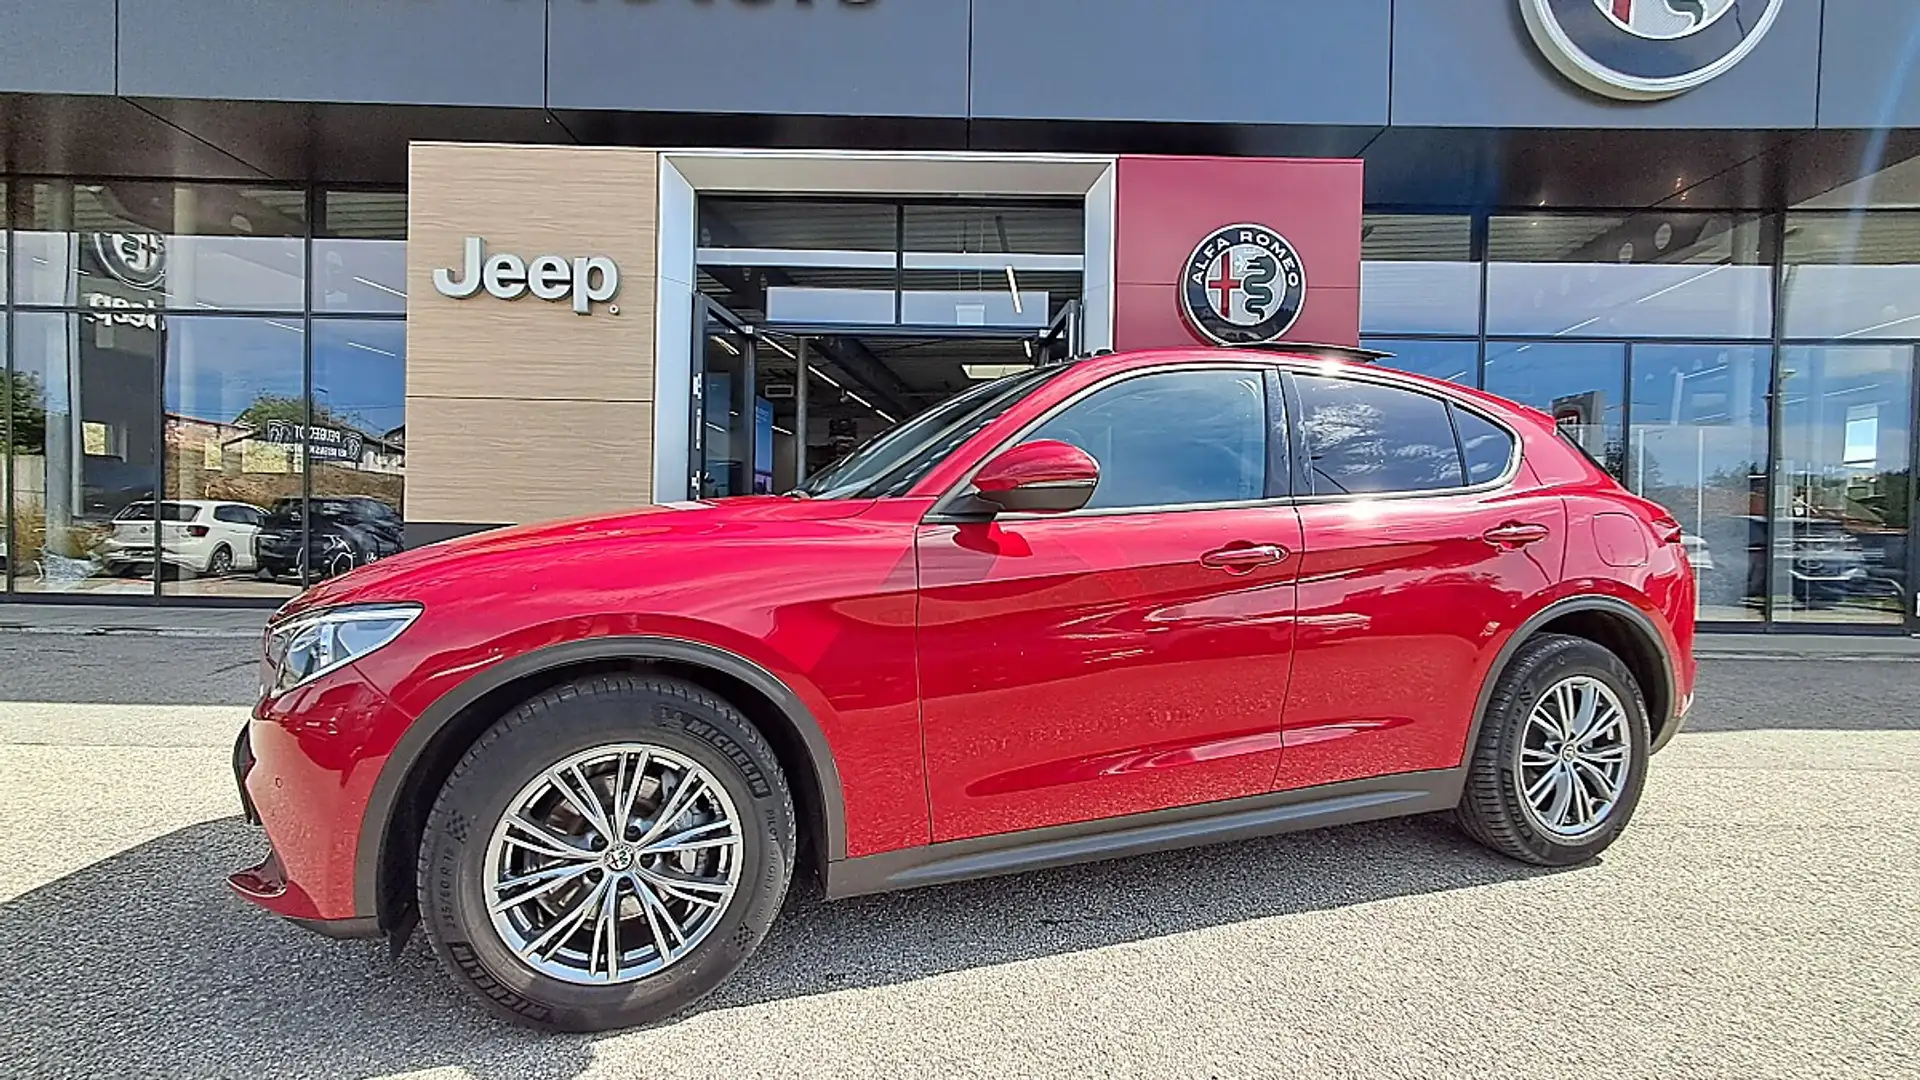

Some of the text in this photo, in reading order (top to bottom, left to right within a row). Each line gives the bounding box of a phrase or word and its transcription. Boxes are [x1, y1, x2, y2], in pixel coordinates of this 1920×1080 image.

[433, 236, 619, 315] Jeep
[1192, 231, 1299, 287] ALFA ROMEO
[685, 719, 770, 795] MICHELIN
[764, 809, 779, 842] PILOT
